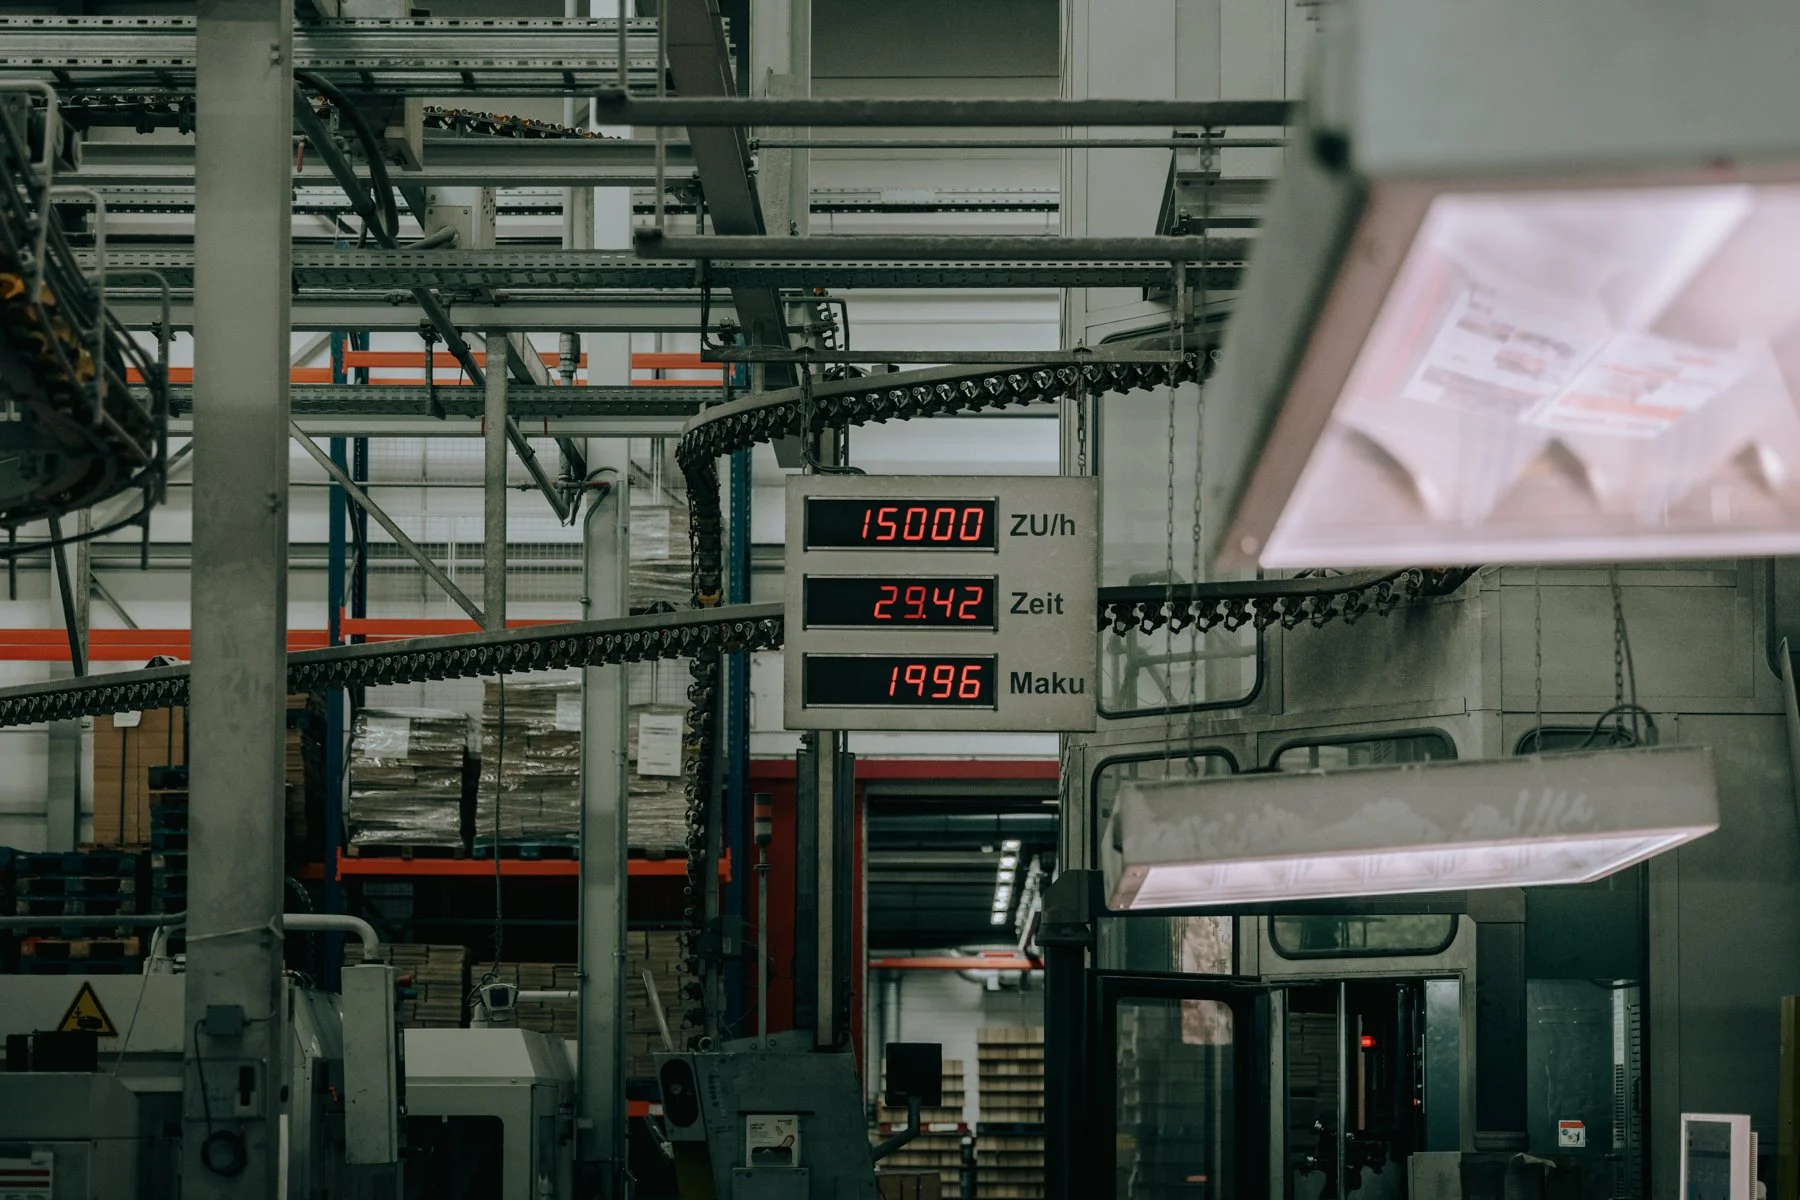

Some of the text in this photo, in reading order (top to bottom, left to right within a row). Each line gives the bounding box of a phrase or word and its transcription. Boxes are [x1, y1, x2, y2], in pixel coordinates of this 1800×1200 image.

[862, 507, 984, 541] 15000
[1010, 514, 1075, 536] ZU/h
[1011, 592, 1063, 614] Zeit
[889, 664, 981, 698] 1996
[1011, 672, 1084, 694] Maku
